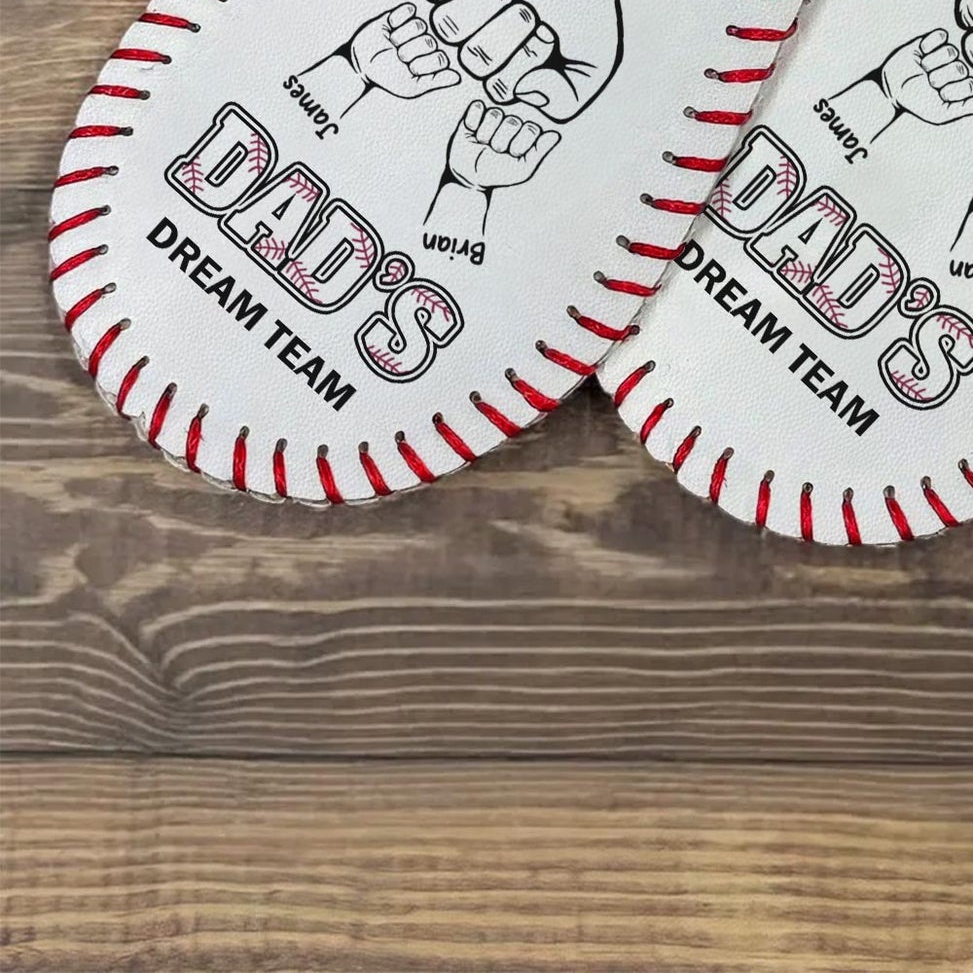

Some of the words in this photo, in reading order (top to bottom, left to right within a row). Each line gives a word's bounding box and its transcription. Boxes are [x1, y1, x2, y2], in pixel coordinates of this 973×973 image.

[283, 74, 339, 141] James
[813, 98, 868, 165] James
[164, 101, 464, 383] DAD'S
[422, 232, 485, 265] Brian
[146, 217, 268, 332] DREAM
[261, 319, 357, 412] TEAM
[673, 240, 793, 354] DREAM
[788, 344, 880, 437] TEAM
